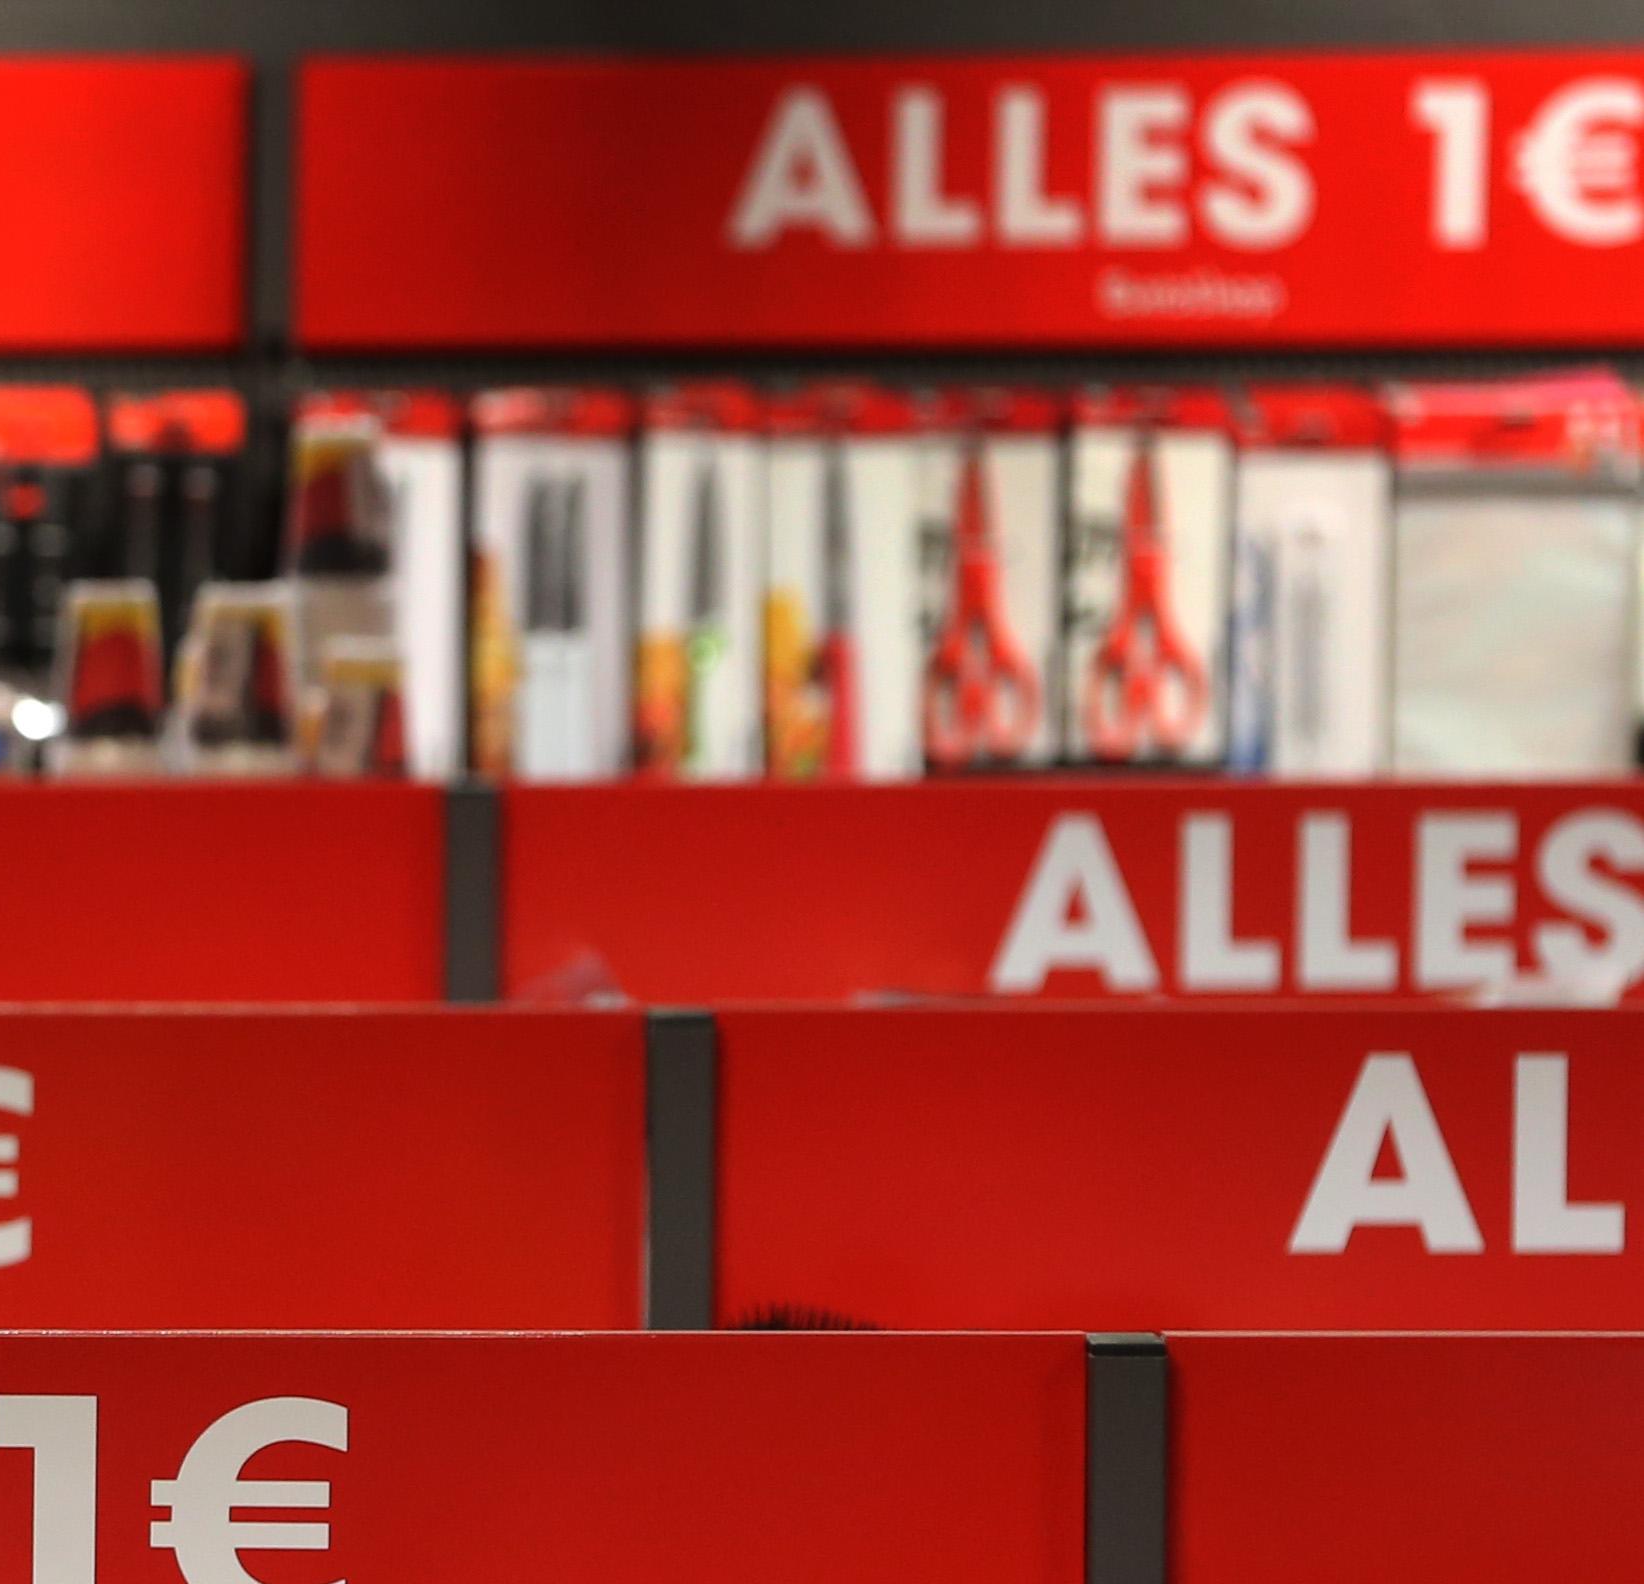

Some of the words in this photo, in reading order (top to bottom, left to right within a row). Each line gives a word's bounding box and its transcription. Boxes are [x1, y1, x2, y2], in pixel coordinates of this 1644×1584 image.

[734, 82, 1315, 249] ALLES
[1412, 79, 1644, 247] 1€
[988, 808, 1644, 995] ALLES
